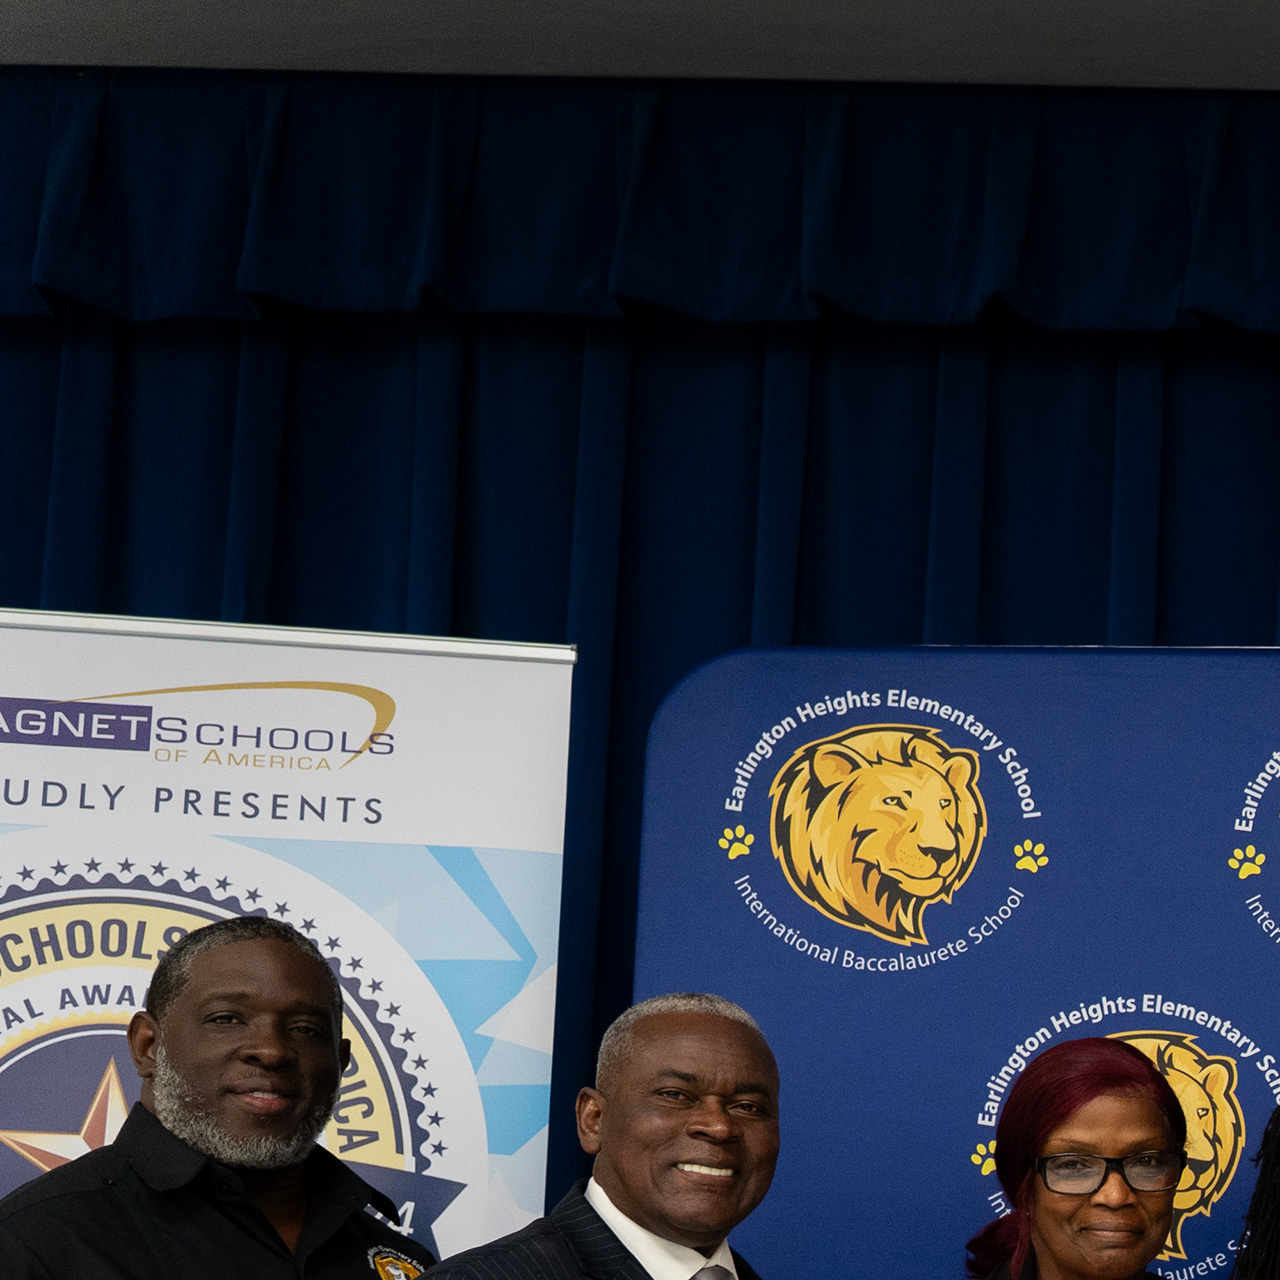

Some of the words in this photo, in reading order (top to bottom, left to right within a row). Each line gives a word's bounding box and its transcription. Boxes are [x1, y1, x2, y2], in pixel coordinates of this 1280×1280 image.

[0, 709, 149, 742] GNET
[154, 715, 395, 757] SCHOOLS
[153, 747, 188, 763] OF
[201, 748, 332, 772] AMERICA
[724, 716, 798, 812] Earlington
[795, 690, 881, 723] Heights
[887, 689, 1004, 751] Elementary
[997, 747, 1042, 819] School
[3, 778, 126, 812] UDLY
[153, 786, 383, 826] PRESENTS
[0, 918, 189, 979] CHOOLS
[734, 874, 839, 965] International
[842, 939, 969, 972] Baccalaurete
[968, 886, 1025, 945] School
[59, 984, 150, 1011] AWA
[977, 1025, 1052, 1127] Earlington
[1050, 995, 1137, 1034] Heights
[1142, 994, 1262, 1059] Elementary
